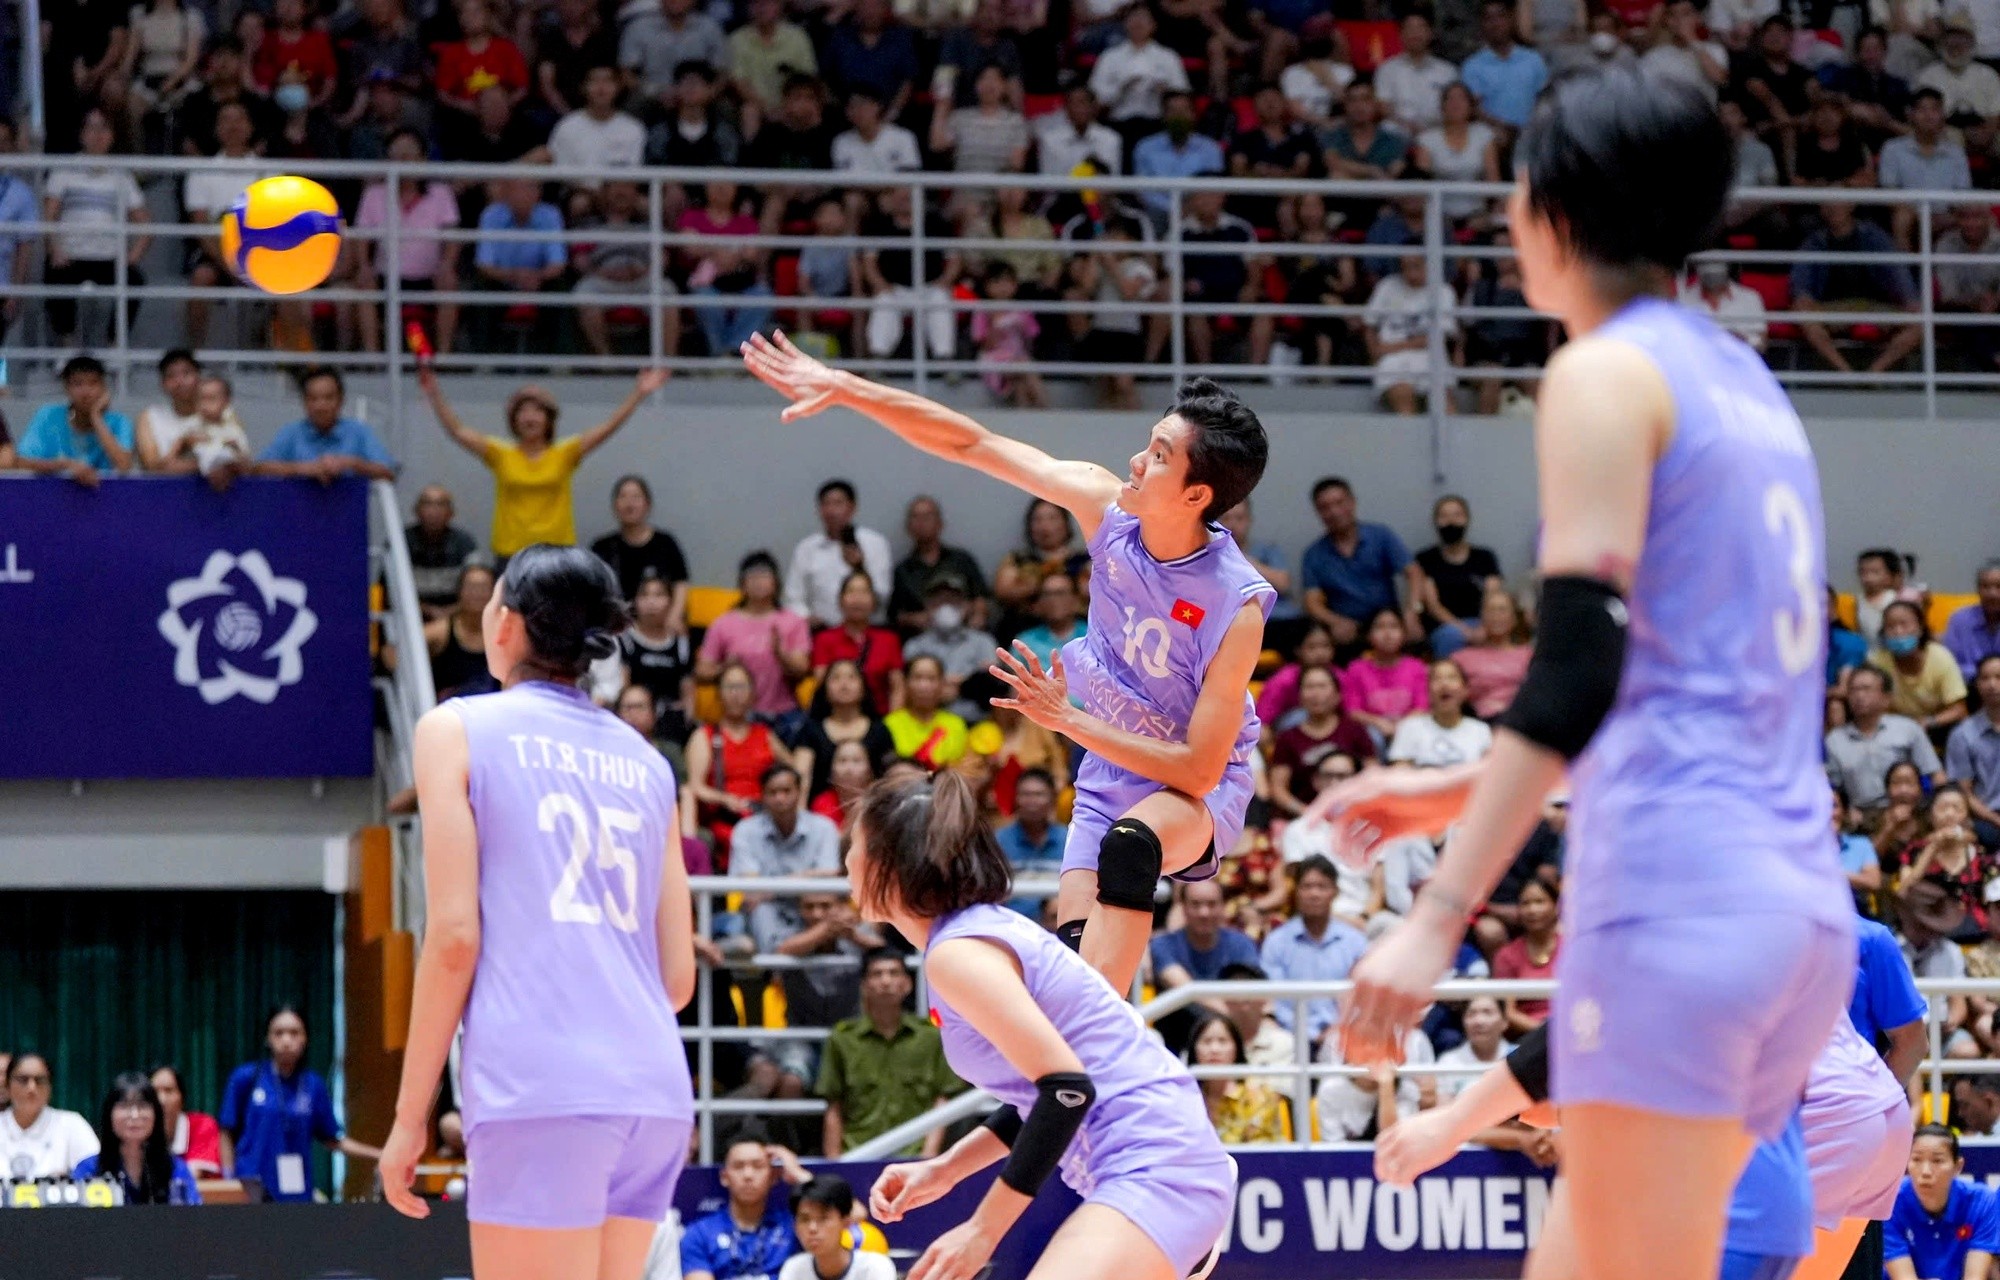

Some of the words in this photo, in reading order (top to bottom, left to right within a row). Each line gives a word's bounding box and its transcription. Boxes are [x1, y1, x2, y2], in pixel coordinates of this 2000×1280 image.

[1122, 606, 1171, 678] 10
[1764, 482, 1820, 677] 3
[537, 792, 642, 933] 25
